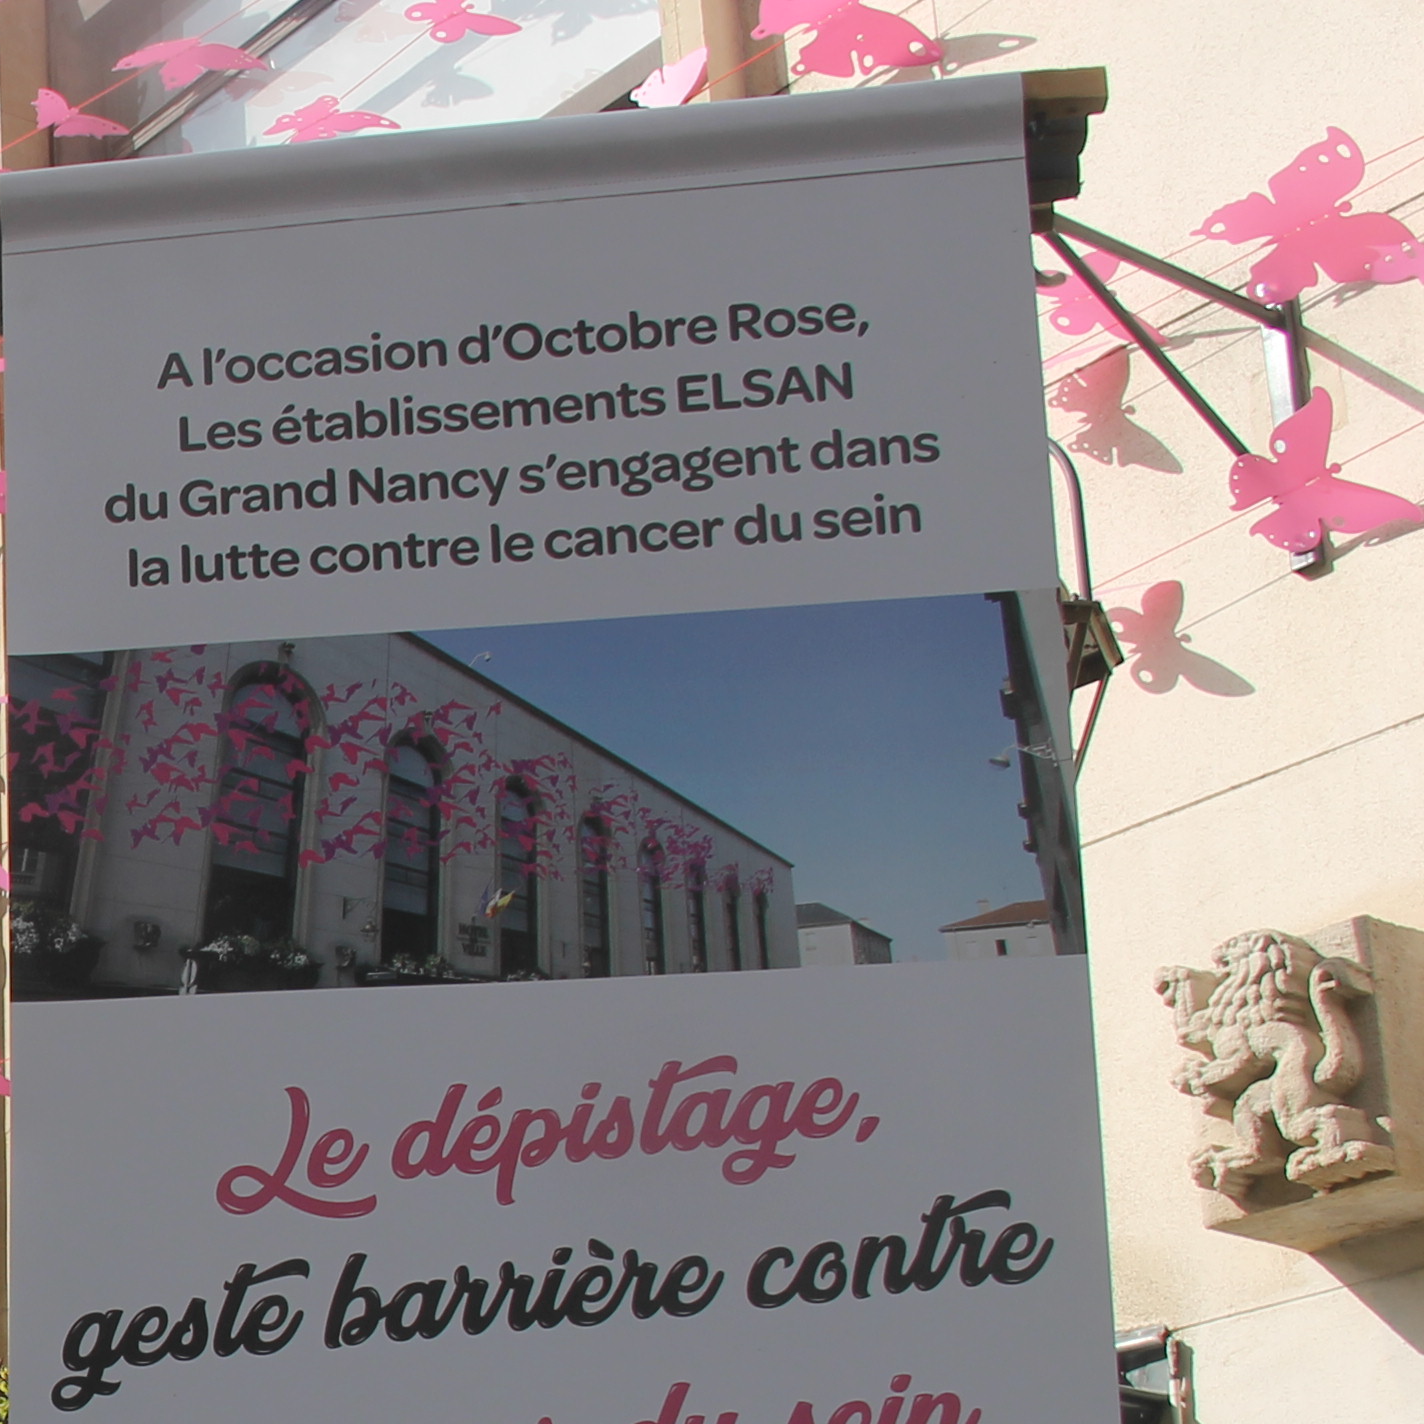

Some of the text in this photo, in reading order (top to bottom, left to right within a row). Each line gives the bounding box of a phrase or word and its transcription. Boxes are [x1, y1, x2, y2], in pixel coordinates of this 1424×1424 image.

[157, 352, 194, 390] A
[728, 303, 869, 342] Rose,
[179, 361, 853, 452] Les établissements ELSAN
[104, 483, 168, 524] du
[179, 467, 337, 518] Grand
[348, 466, 510, 507] Nancy
[810, 428, 940, 471] dans
[128, 493, 922, 588] la lutte contre le cancer du sein
[214, 1054, 881, 1220] Le dépistage,
[49, 1188, 1056, 1413] geste barrière contre
